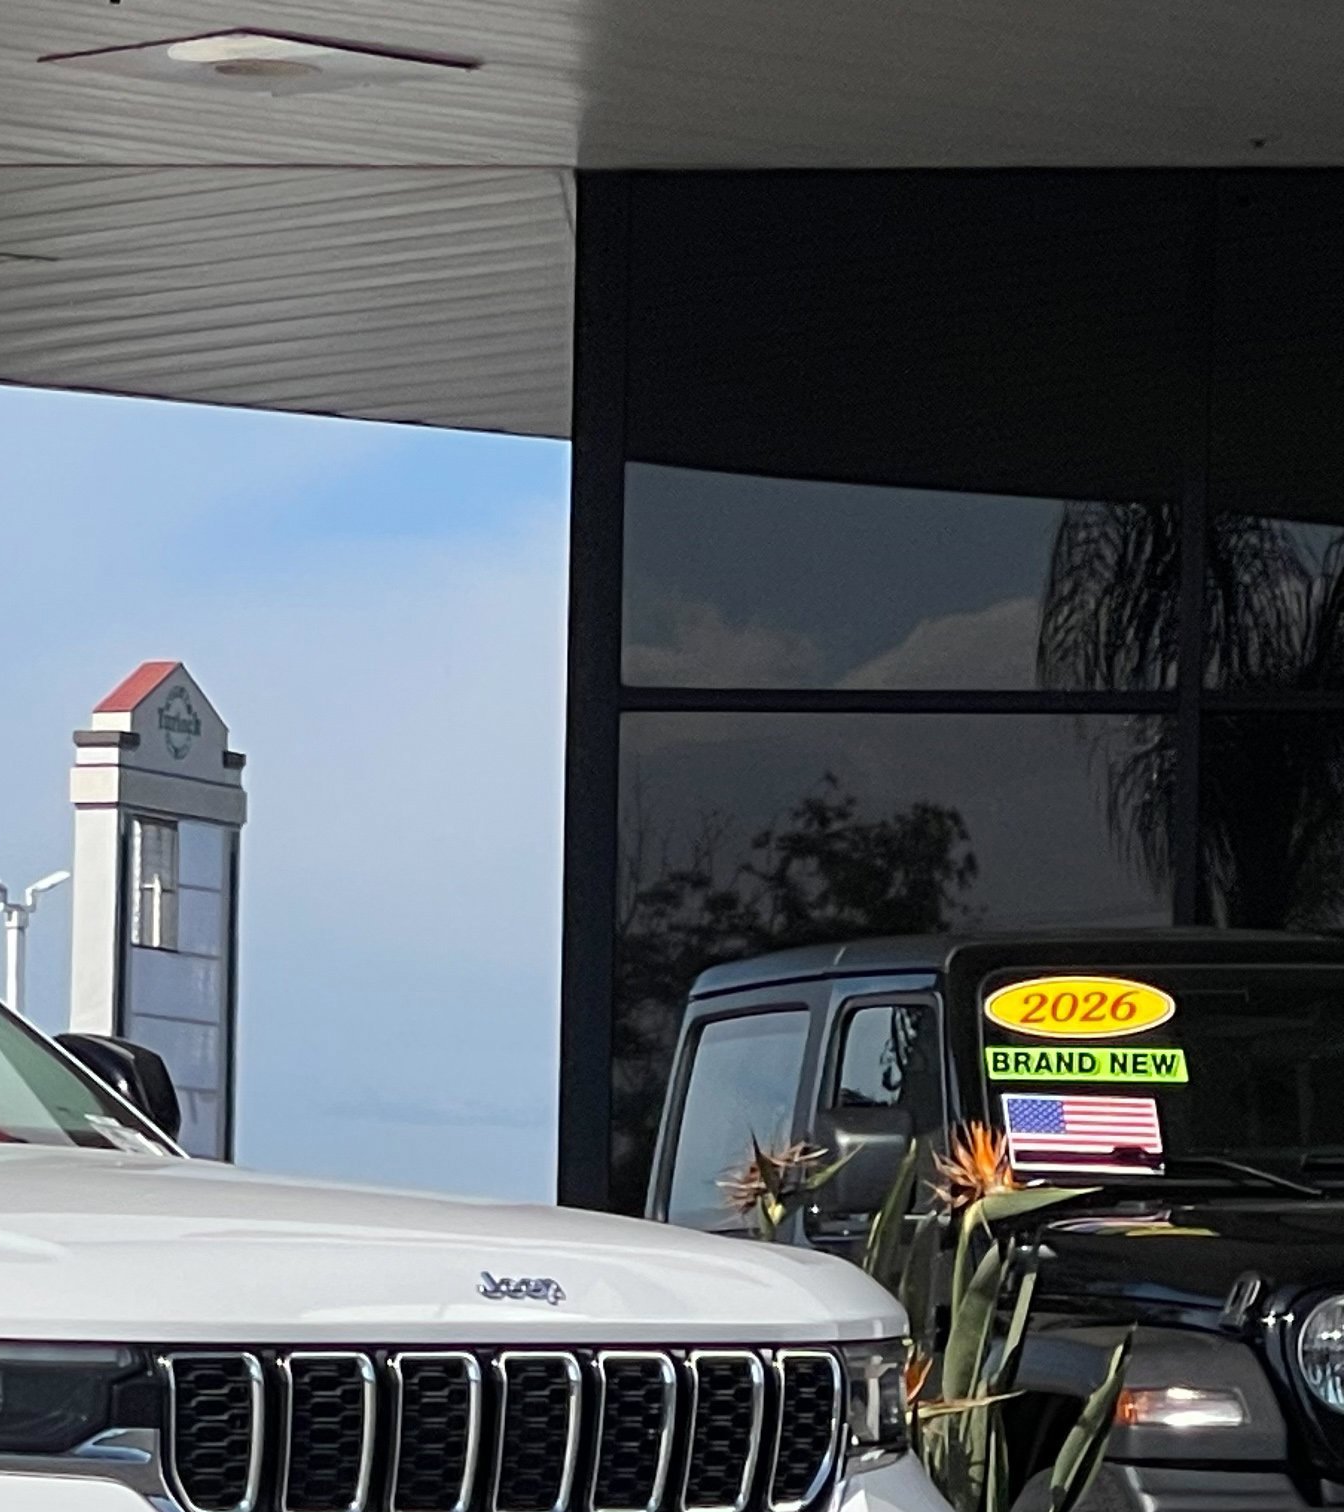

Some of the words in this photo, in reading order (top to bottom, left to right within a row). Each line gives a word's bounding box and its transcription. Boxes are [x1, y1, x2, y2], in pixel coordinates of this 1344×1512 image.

[1020, 990, 1139, 1023] 2026
[992, 1052, 1098, 1075] BRAND
[1110, 1053, 1178, 1076] NEW
[476, 1271, 567, 1305] Jeep
